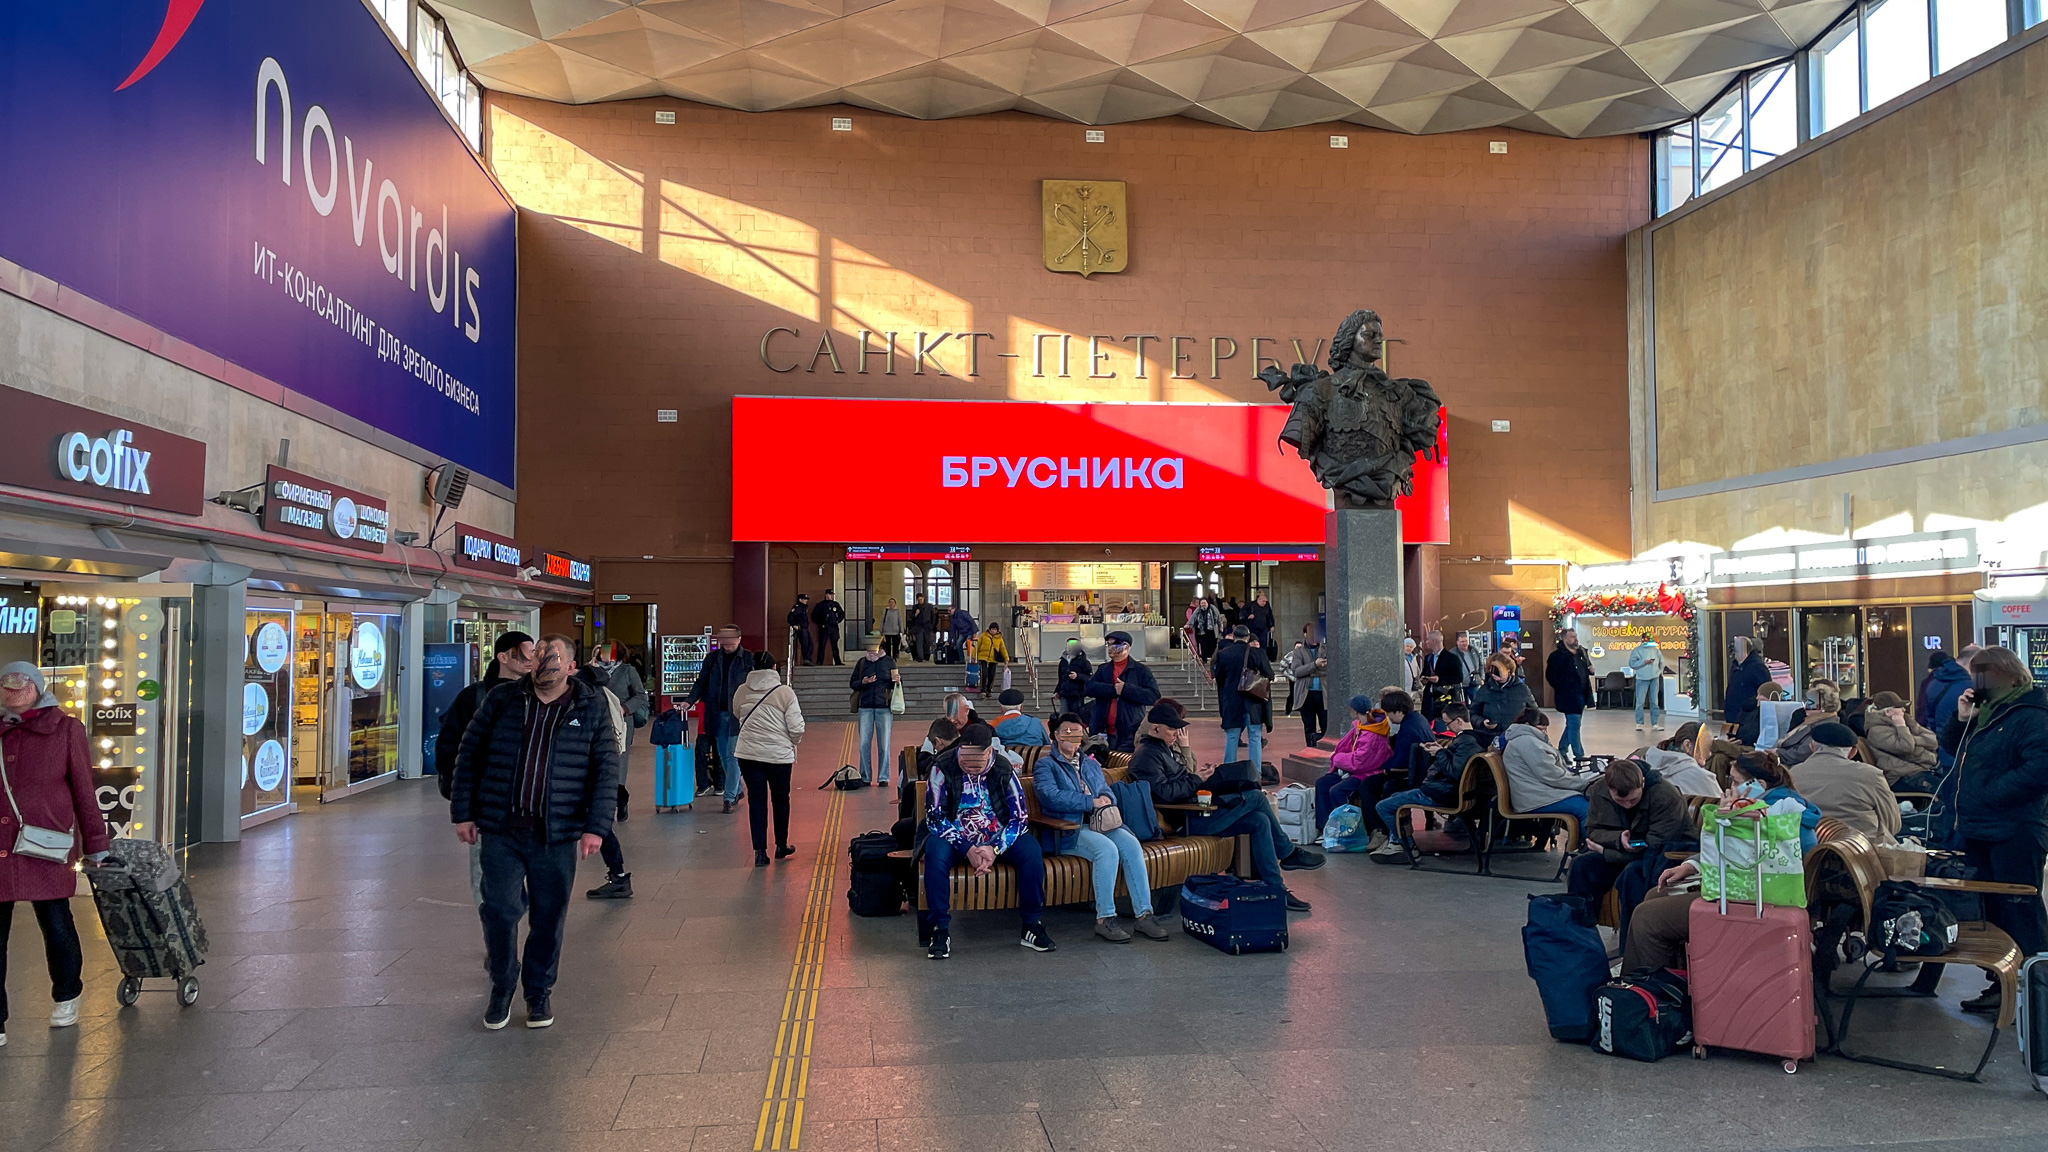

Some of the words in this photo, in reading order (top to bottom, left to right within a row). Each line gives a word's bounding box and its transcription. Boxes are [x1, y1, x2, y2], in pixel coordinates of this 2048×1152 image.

[255, 57, 481, 343] novardis
[254, 241, 376, 347] ИТ-КОНСАЛТИНГ
[377, 327, 401, 366] ДЛЯ
[402, 344, 444, 393] ЗРЕЛОГО
[445, 373, 480, 416] БИЗНЕСА
[759, 327, 1406, 380] САНКТ-ПЕТЕРБУГ
[64, 429, 151, 495] cofix
[280, 480, 332, 510] ФИРМЕННЫЙ
[287, 505, 324, 530] МАГАЗИН
[360, 504, 389, 529] ШОКОЛАД
[359, 524, 388, 545] КОНФЕТЫ
[464, 535, 492, 562] ПОДАРКИ
[494, 542, 521, 566] СУВЕНИРЫ
[570, 560, 590, 583] ПЕКАРНЯ
[1503, 610, 1515, 618] ВТБ
[2001, 604, 2032, 614] COFFEE
[1923, 635, 1942, 650] UR
[96, 706, 133, 720] cofix
